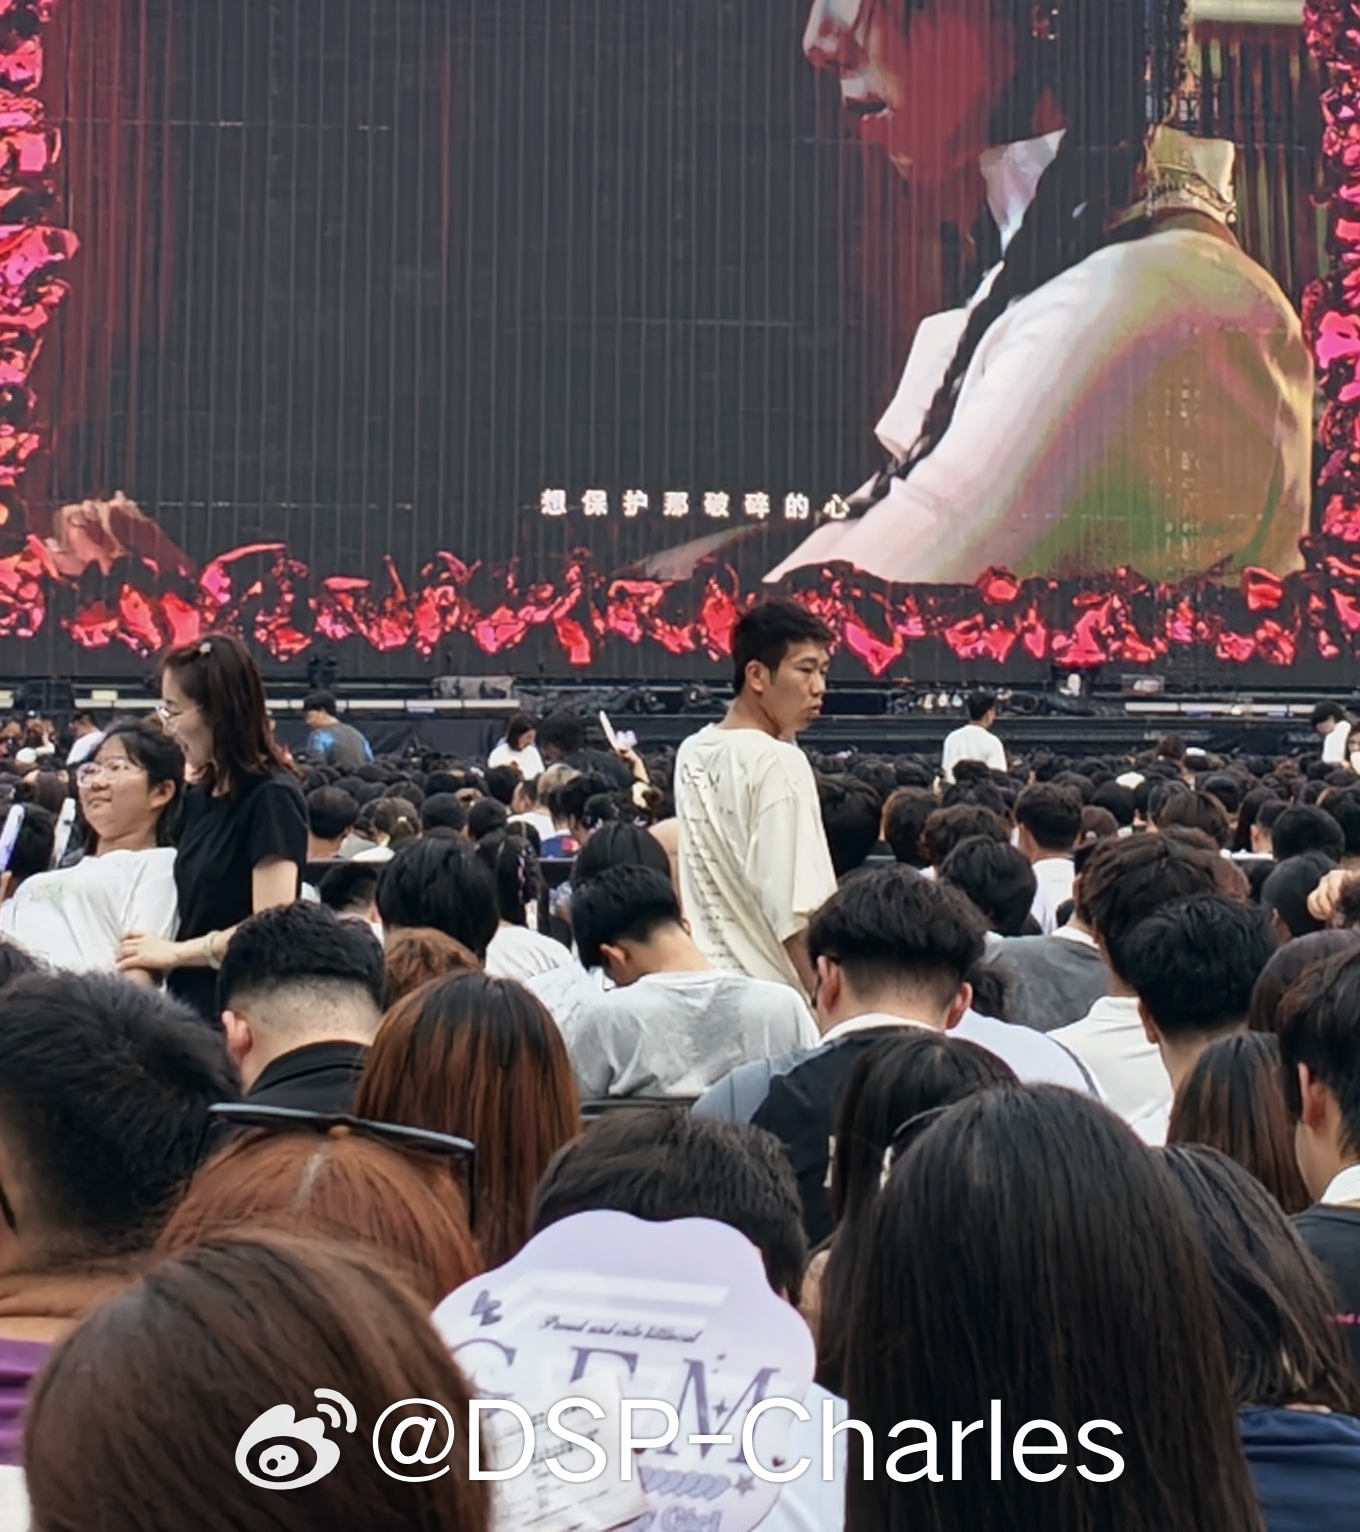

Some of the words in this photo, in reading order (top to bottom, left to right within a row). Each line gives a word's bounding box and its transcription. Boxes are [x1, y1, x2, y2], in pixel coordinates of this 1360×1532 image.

[539, 488, 850, 519] 想保护那破碎的心
